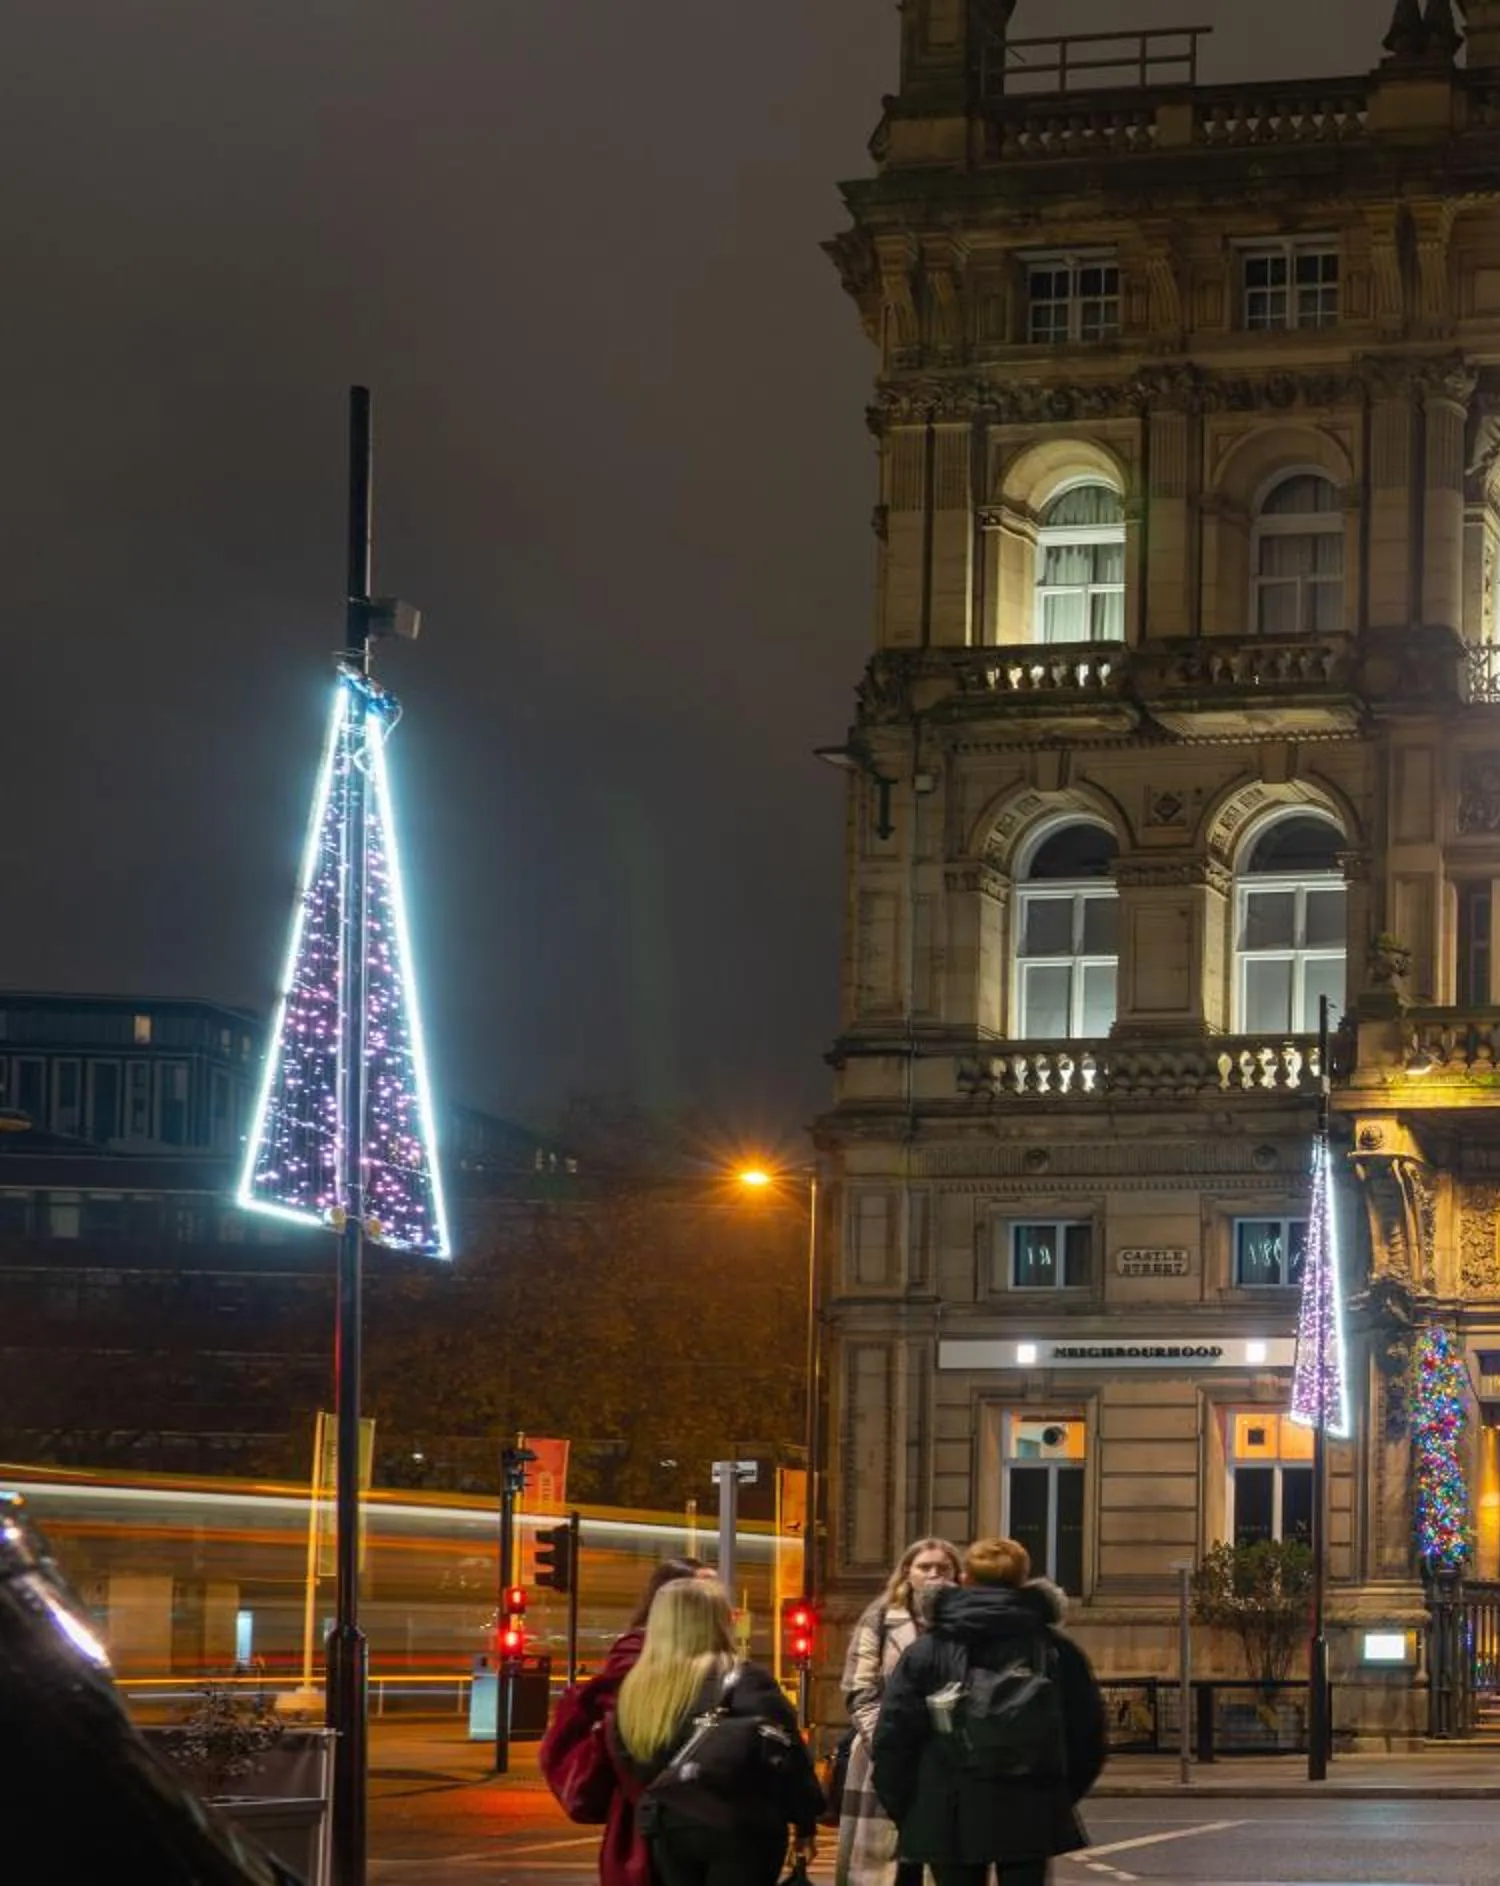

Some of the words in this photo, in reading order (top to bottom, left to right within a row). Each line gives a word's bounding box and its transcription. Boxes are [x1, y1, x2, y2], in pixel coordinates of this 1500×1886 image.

[1122, 1250, 1184, 1262] CASTLE
[1122, 1263, 1184, 1274] STREET
[1054, 1346, 1222, 1359] NEIGHBOURHOOD
